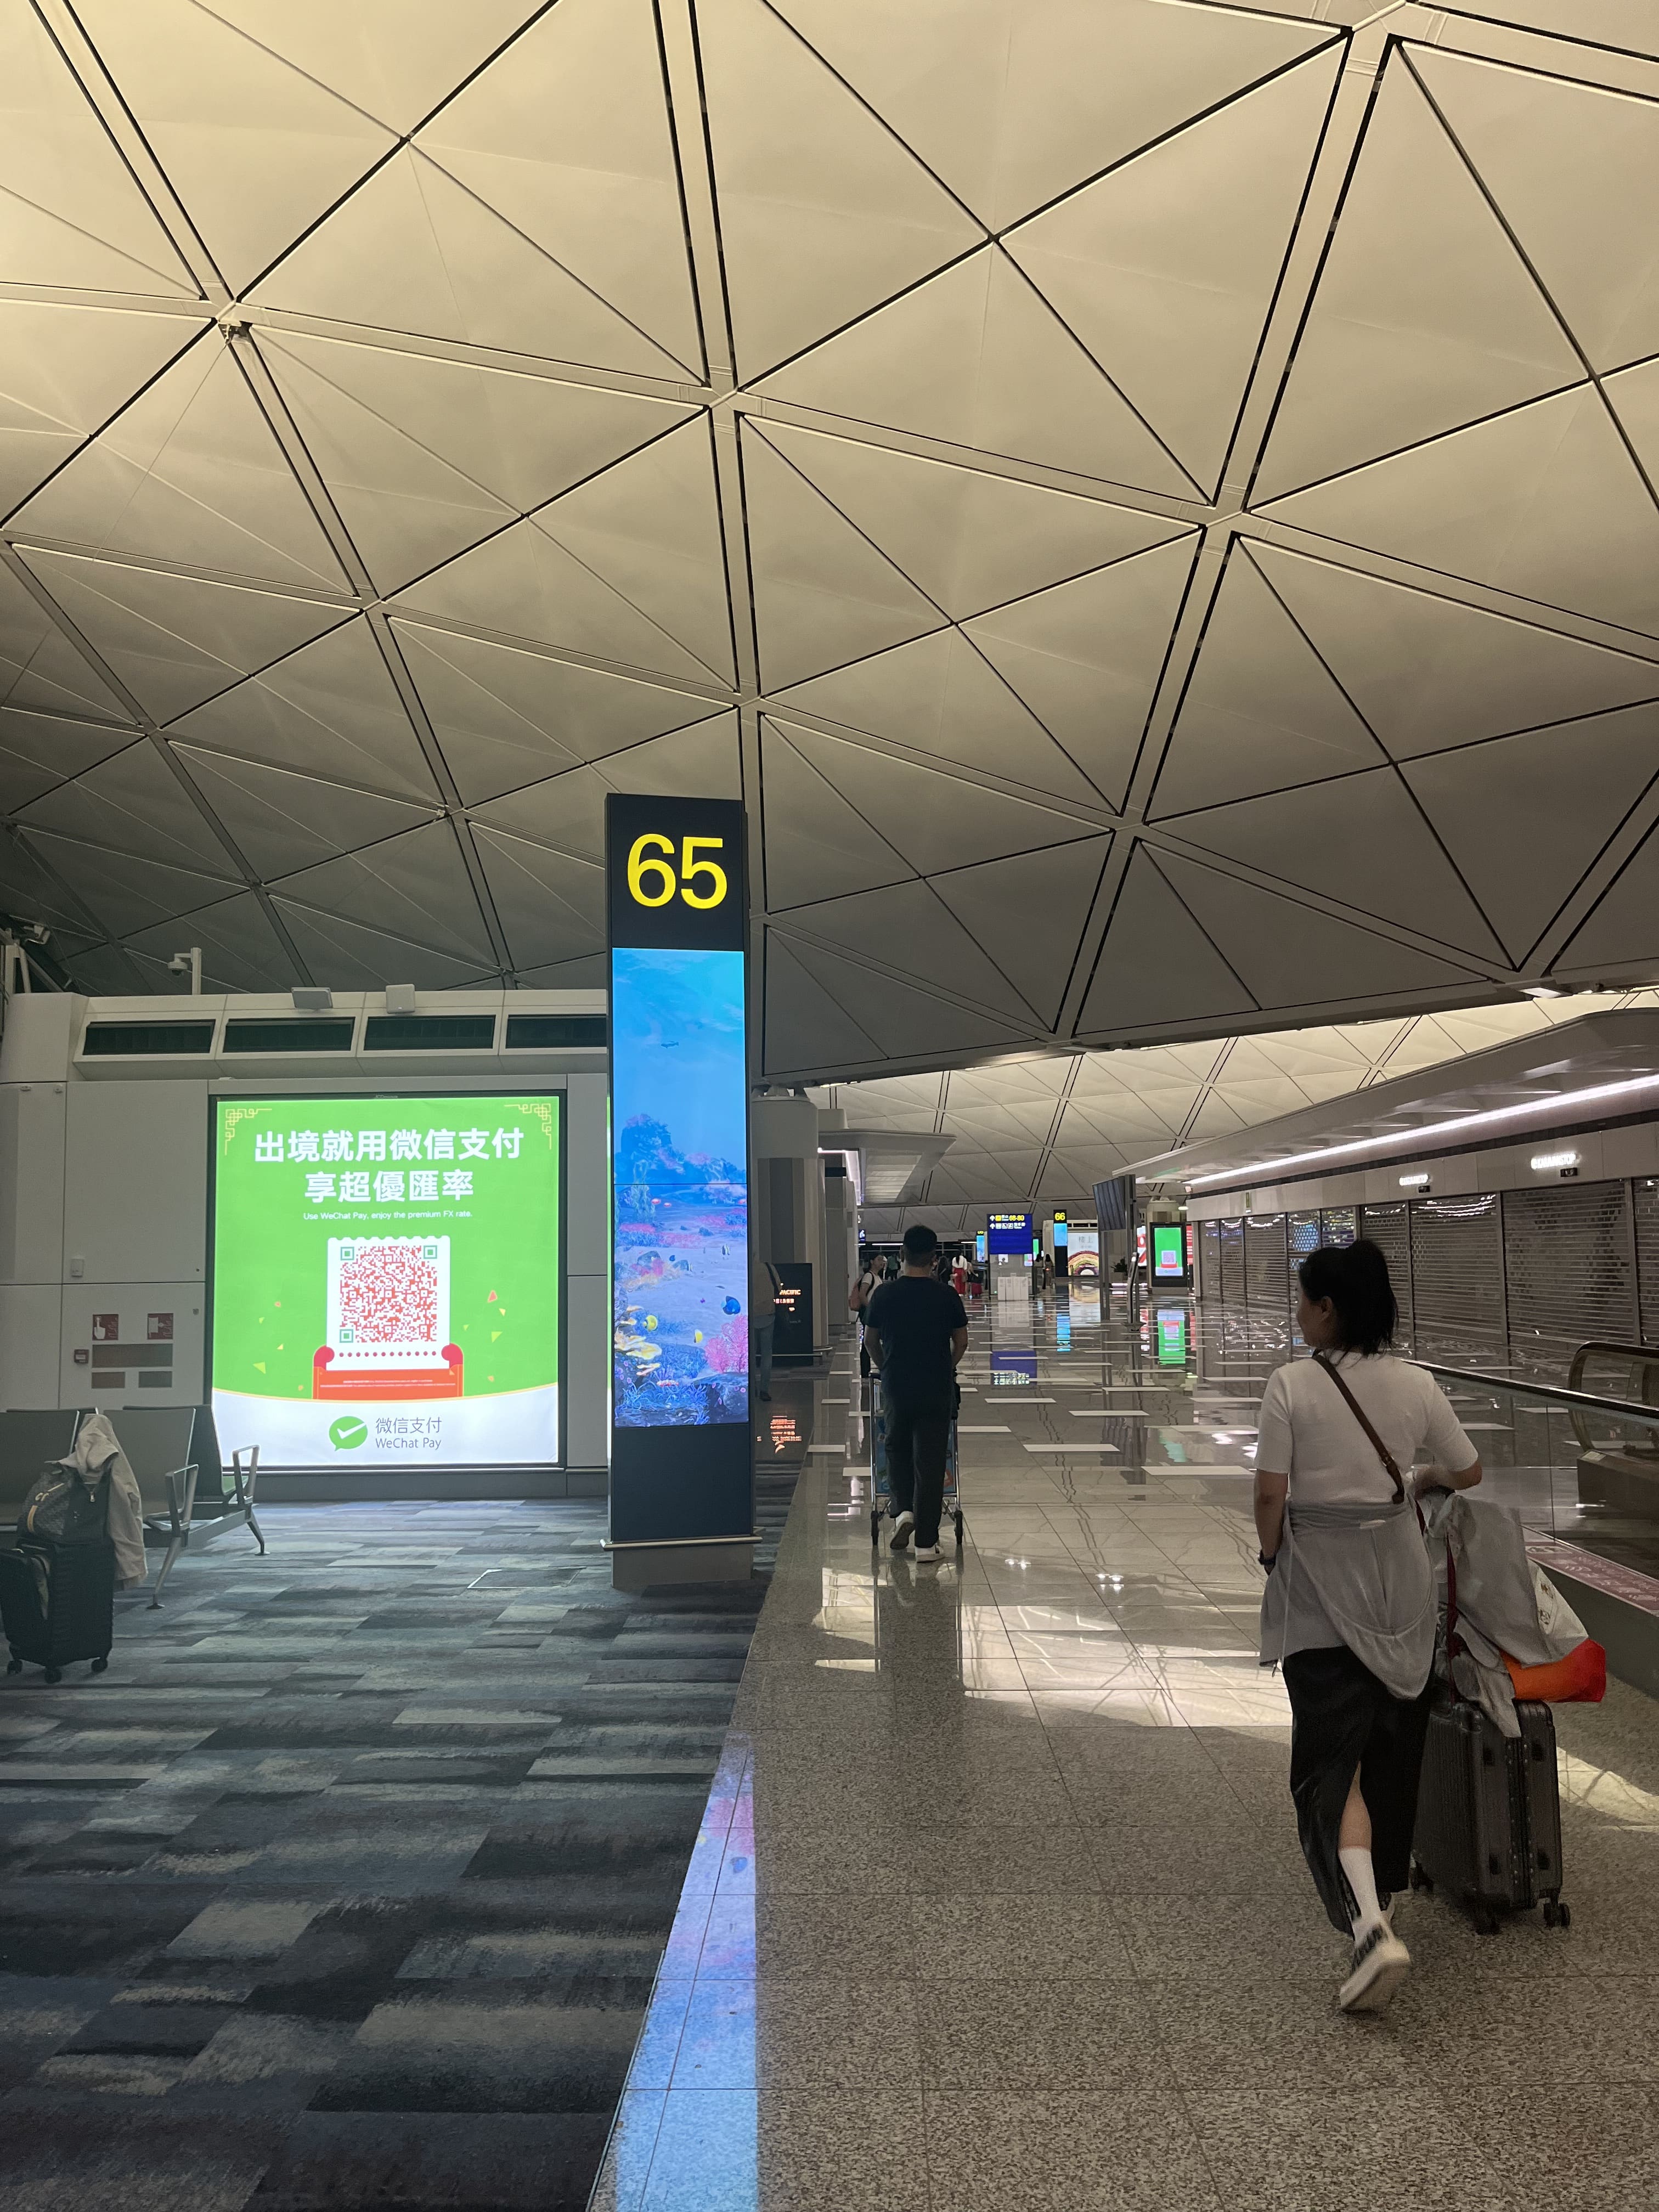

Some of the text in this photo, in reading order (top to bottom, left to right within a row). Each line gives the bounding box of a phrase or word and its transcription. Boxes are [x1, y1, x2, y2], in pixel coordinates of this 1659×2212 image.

[627, 833, 728, 910] 65
[254, 1127, 524, 1163] 出境就用微信支付
[304, 1169, 474, 1203] 享超優匯率
[371, 1211, 392, 1220] enjoy
[408, 1211, 441, 1220] premium
[1054, 1212, 1065, 1221] 66
[376, 1417, 442, 1434] 微信支付
[375, 1437, 442, 1451] WeChat Pay
